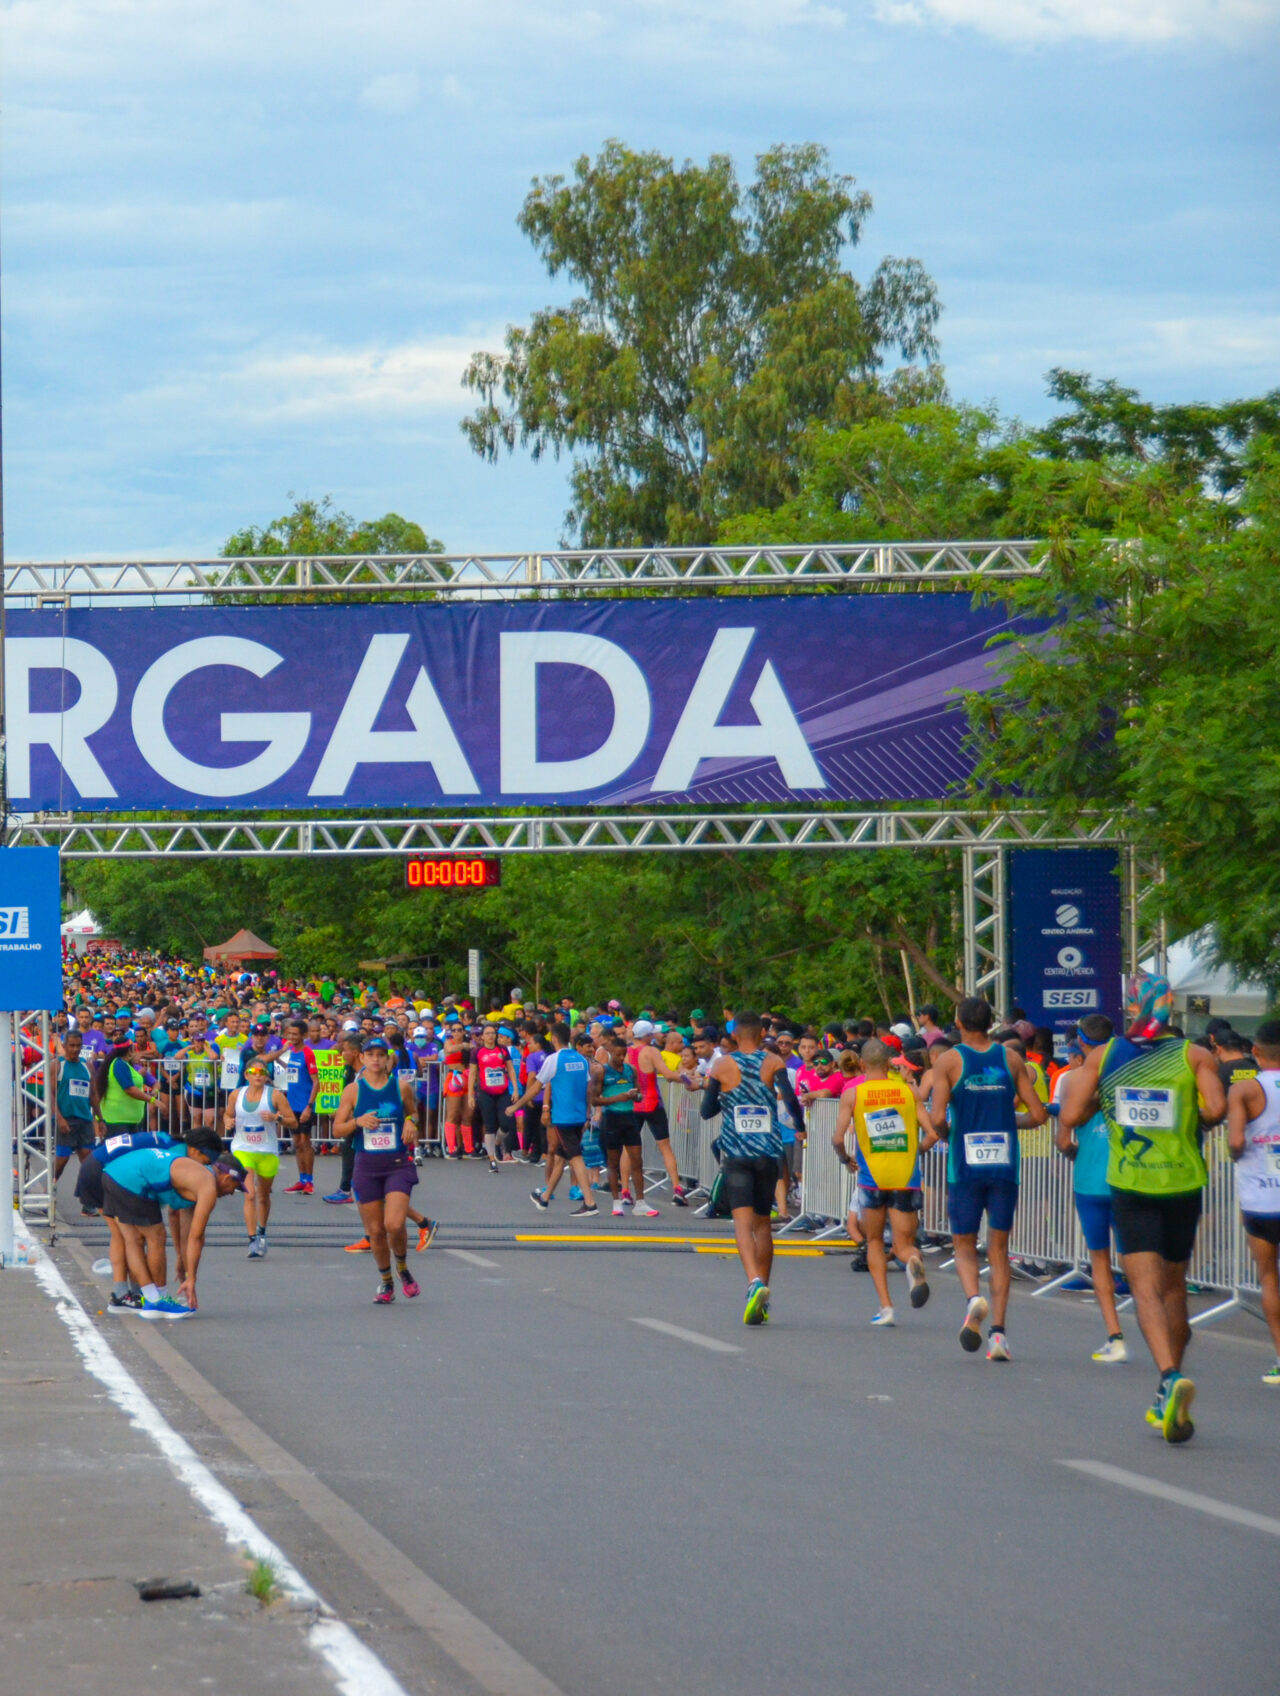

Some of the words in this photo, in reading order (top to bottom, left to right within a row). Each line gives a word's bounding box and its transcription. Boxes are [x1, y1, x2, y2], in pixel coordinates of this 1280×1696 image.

[1041, 928, 1065, 936] CENTRO
[1049, 992, 1091, 1005] SESI
[1129, 1107, 1160, 1121] 069
[741, 1119, 762, 1129] 079
[875, 1121, 896, 1132] 044
[371, 1136, 391, 1146] 026
[975, 1148, 1000, 1160] 077
